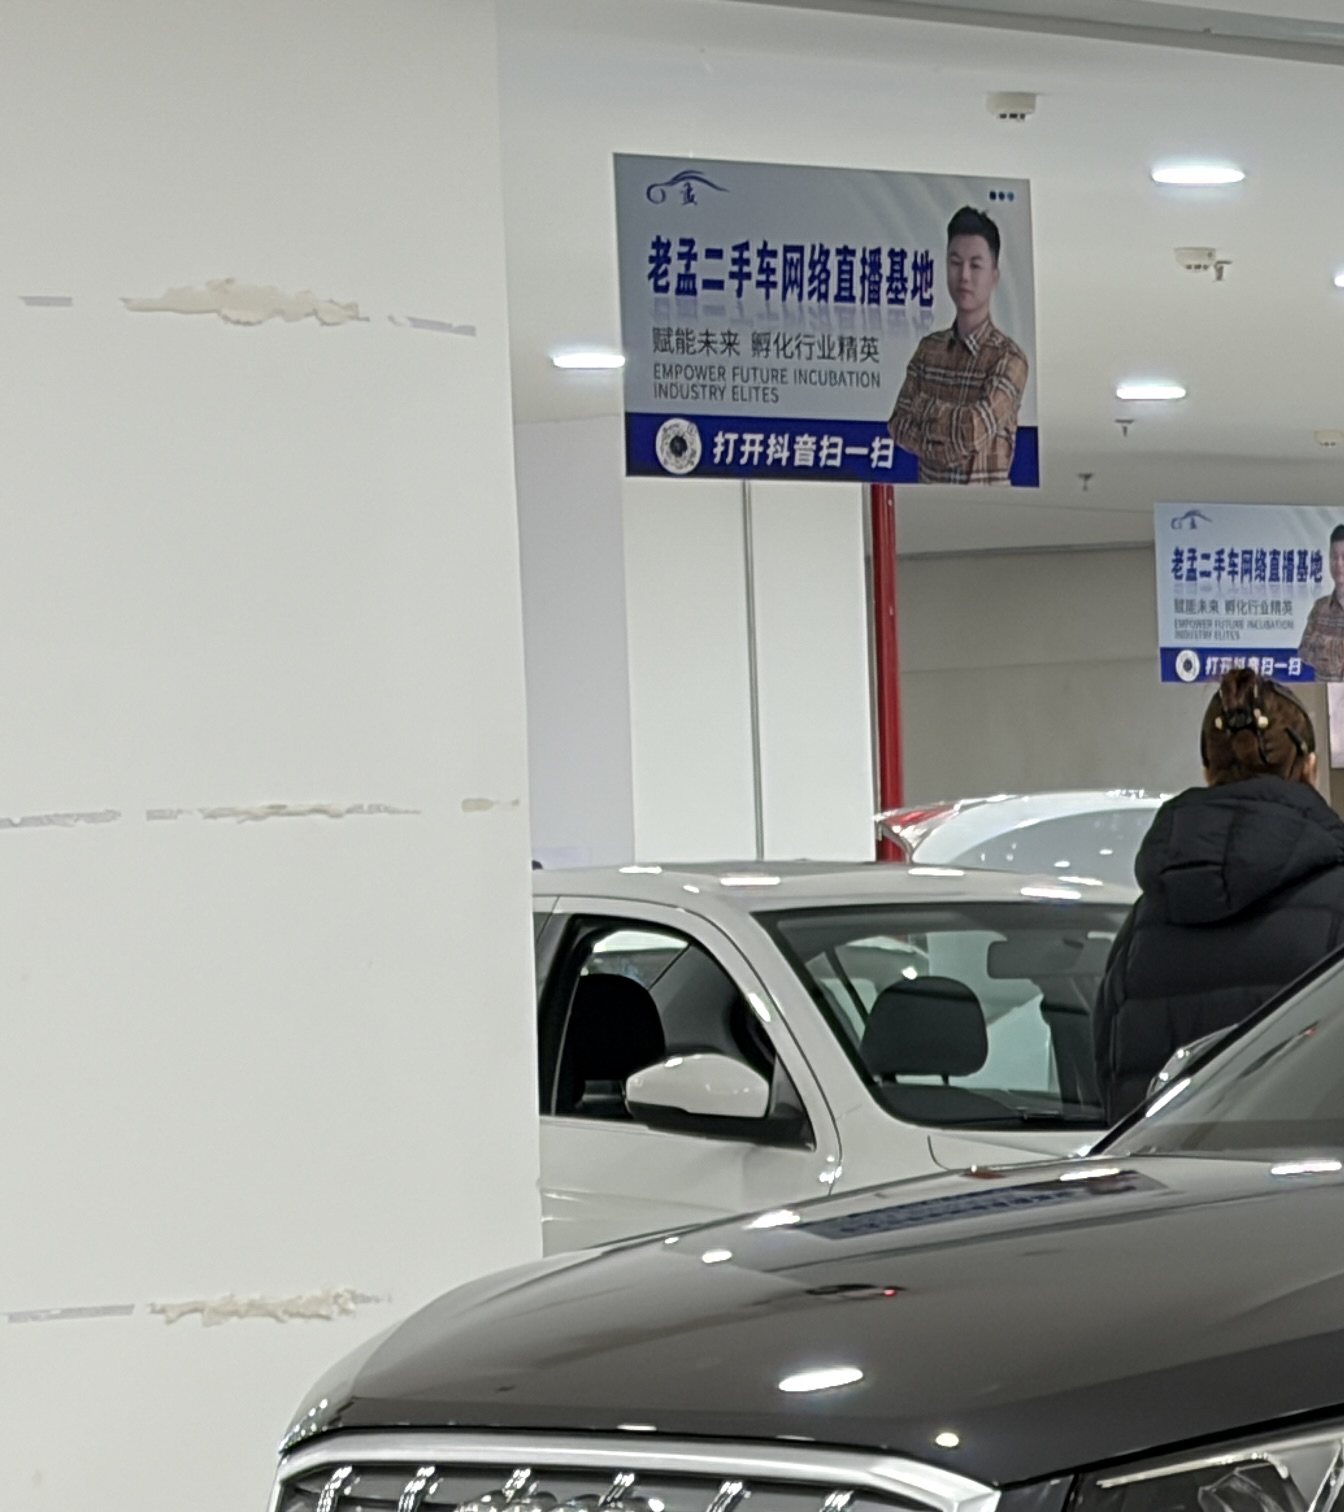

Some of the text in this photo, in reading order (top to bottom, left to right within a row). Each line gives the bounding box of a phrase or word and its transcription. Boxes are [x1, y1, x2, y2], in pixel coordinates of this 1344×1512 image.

[648, 235, 934, 307] 老孟二手车网络直播基地
[652, 327, 880, 364] 赋能未来 孵化行业精英
[653, 363, 881, 389] EMPOWER FUTURE INCUBATION
[653, 384, 779, 404] INDUSTRY ELITES
[713, 431, 894, 470] 打开抖音扫一扫
[1171, 547, 1323, 584] 老孟二手车网络直播基地
